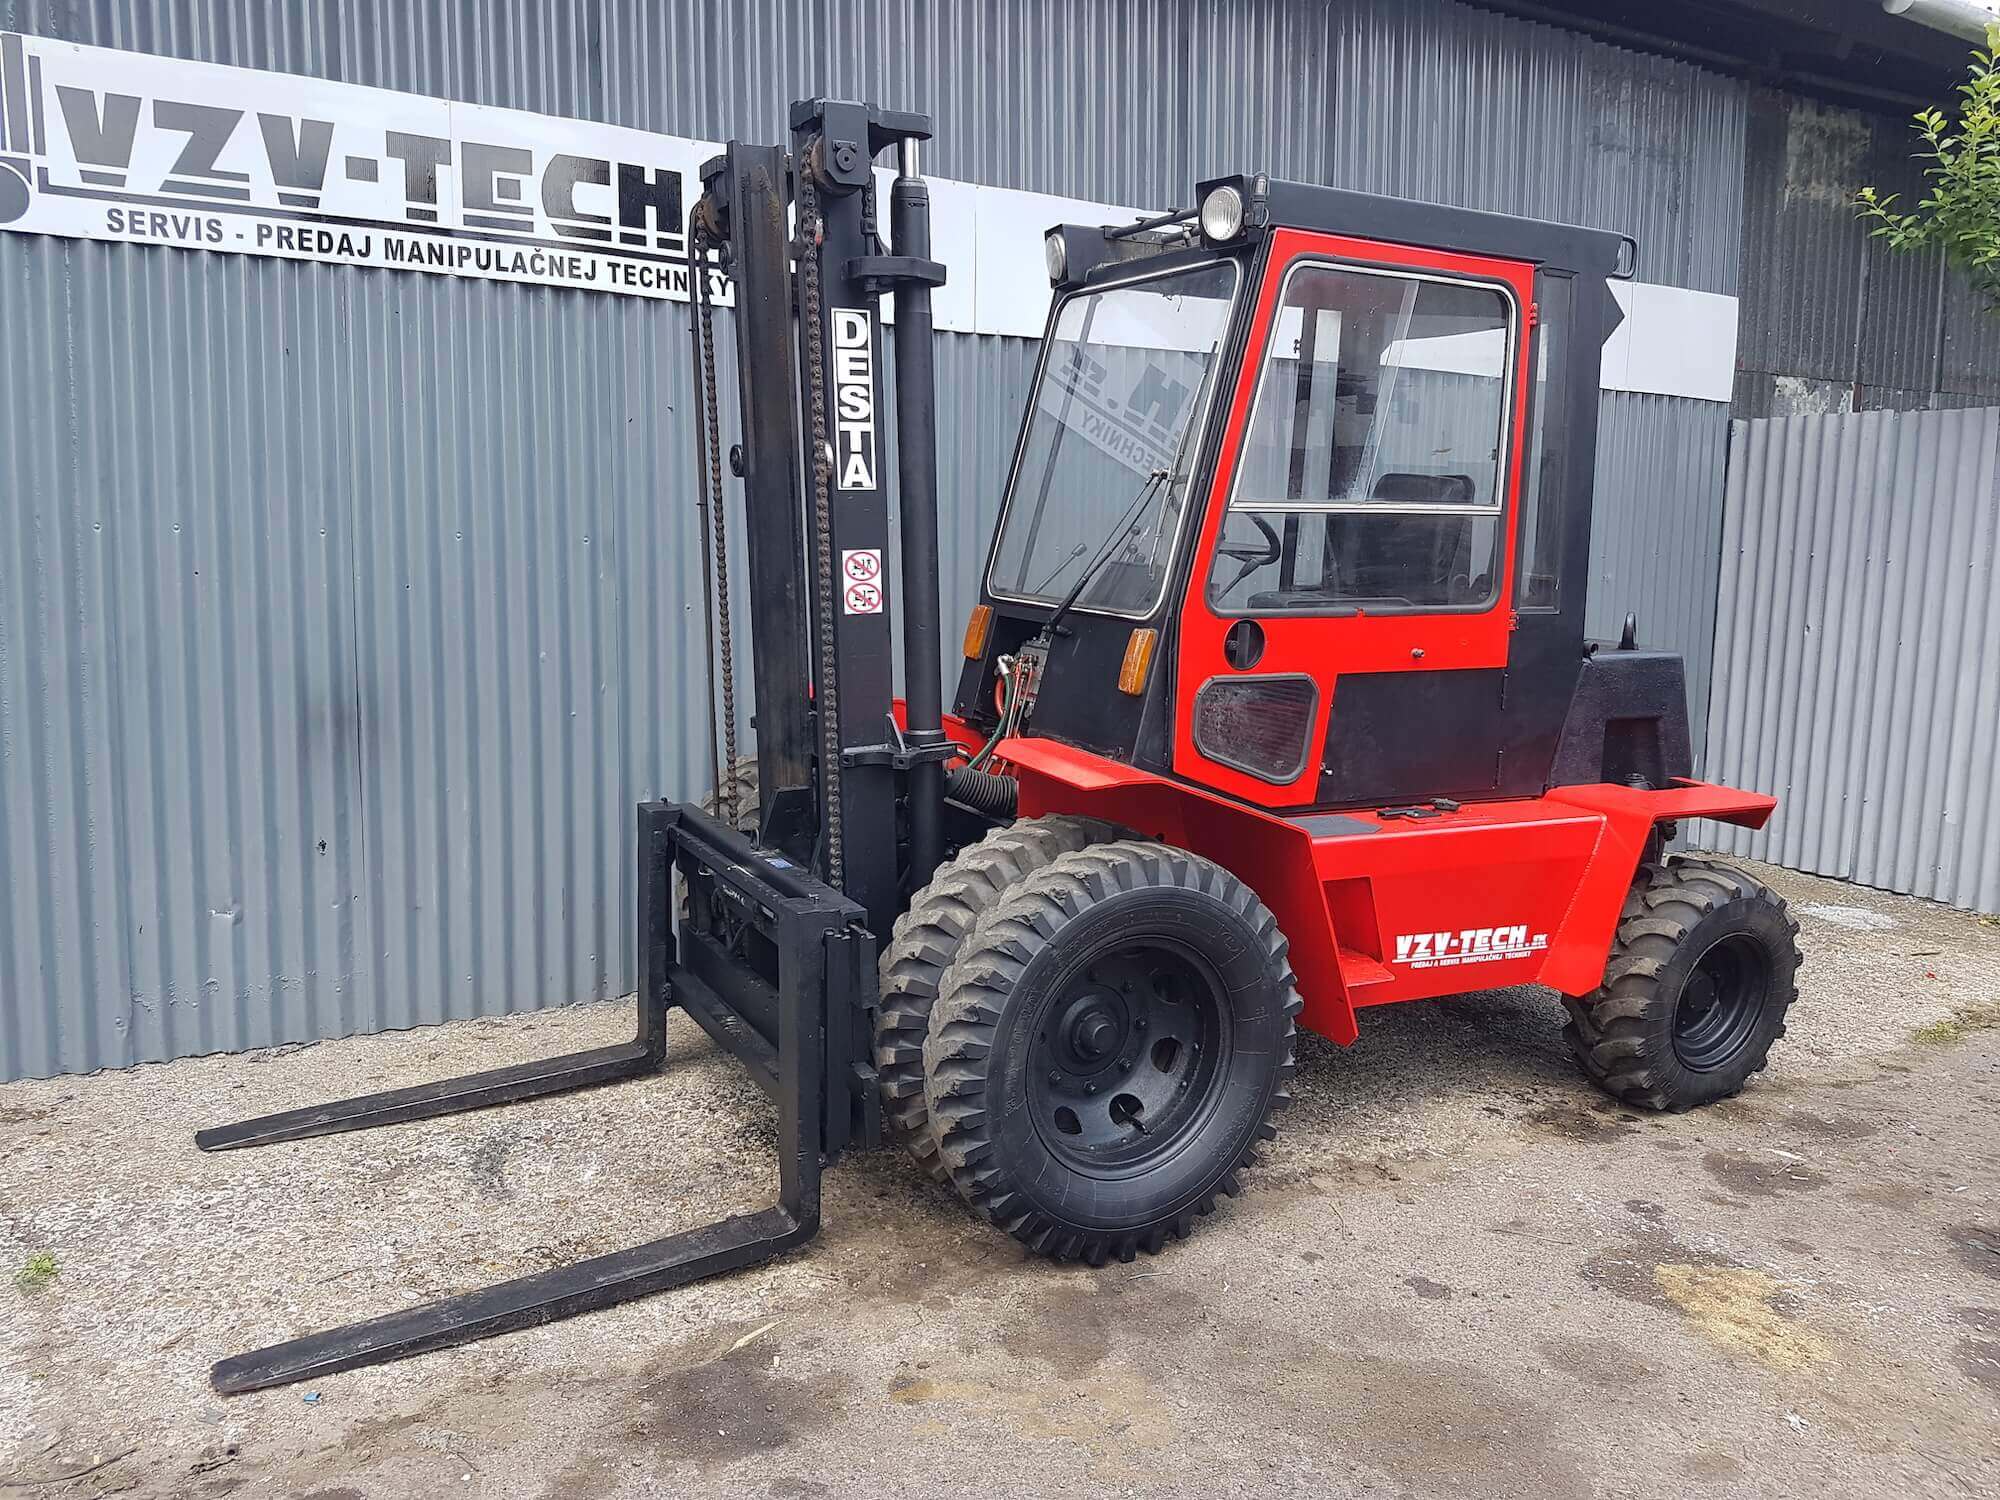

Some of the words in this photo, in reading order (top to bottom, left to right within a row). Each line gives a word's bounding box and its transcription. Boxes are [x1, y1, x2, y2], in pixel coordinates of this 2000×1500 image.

[55, 85, 684, 251] VZV-TECH
[106, 207, 225, 244] SERVIS
[256, 223, 373, 260] PREDAJ
[383, 235, 598, 282] MANIPULAČNEJ
[607, 261, 730, 297] TECHNY
[833, 310, 874, 488] DESTA
